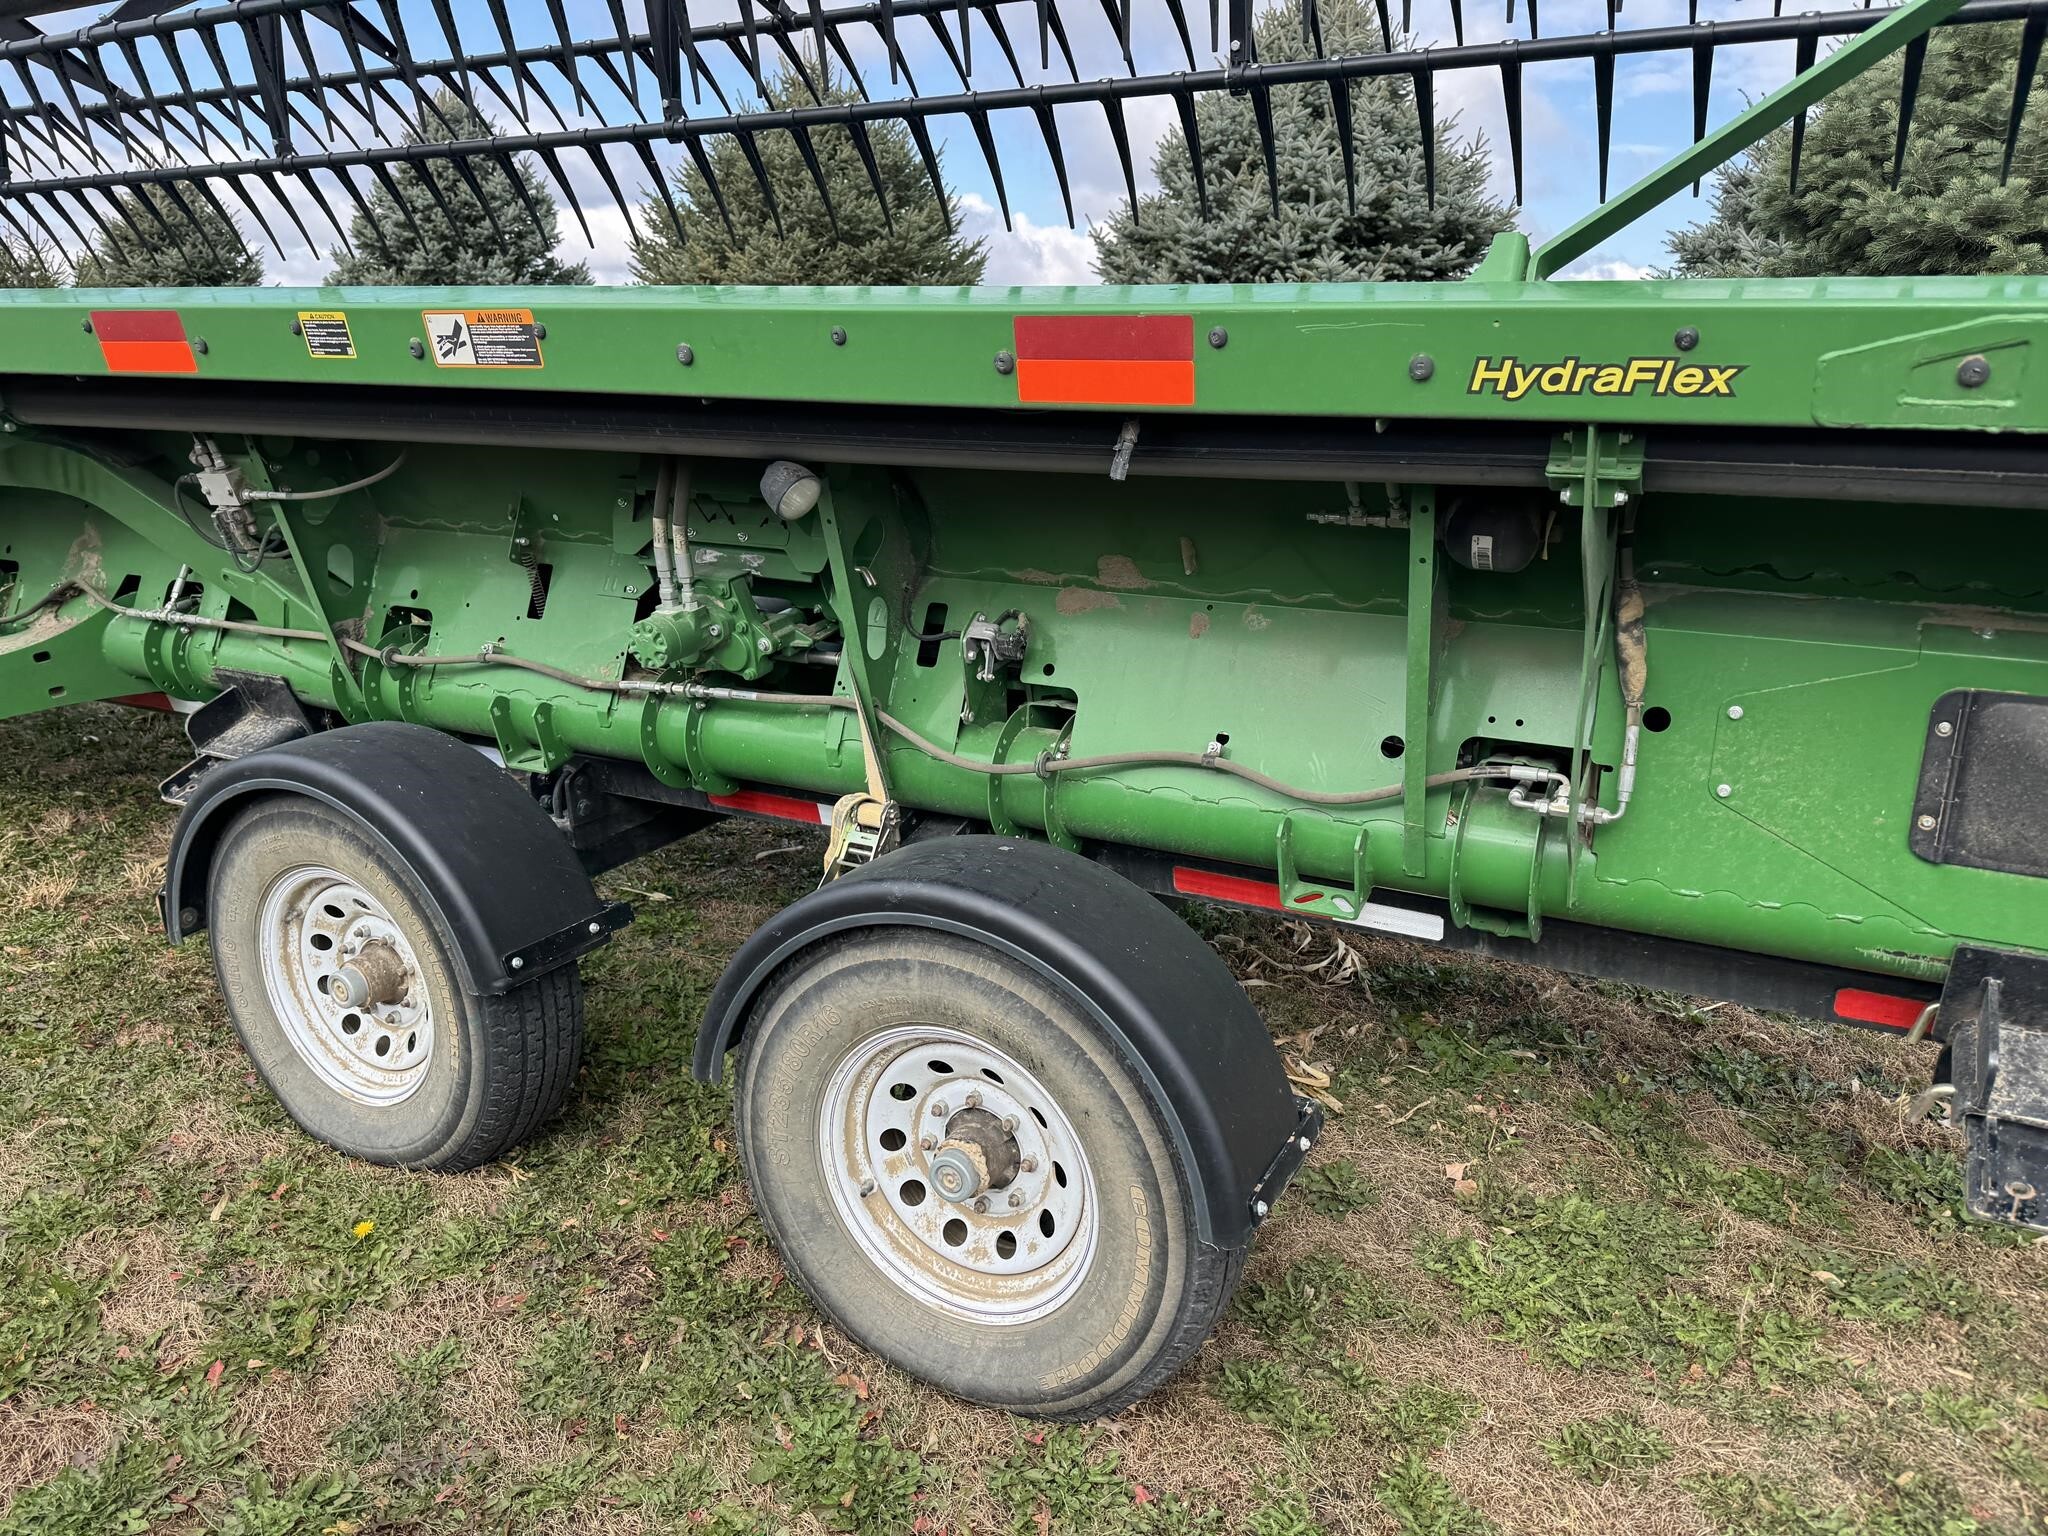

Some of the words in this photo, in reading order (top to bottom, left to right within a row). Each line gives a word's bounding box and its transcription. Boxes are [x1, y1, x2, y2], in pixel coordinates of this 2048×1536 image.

[485, 313, 523, 323] WARNING
[1469, 358, 1740, 400] HydraFlex
[767, 1004, 842, 1167] ST235/80R16
[1037, 1184, 1152, 1390] COMMODORE
